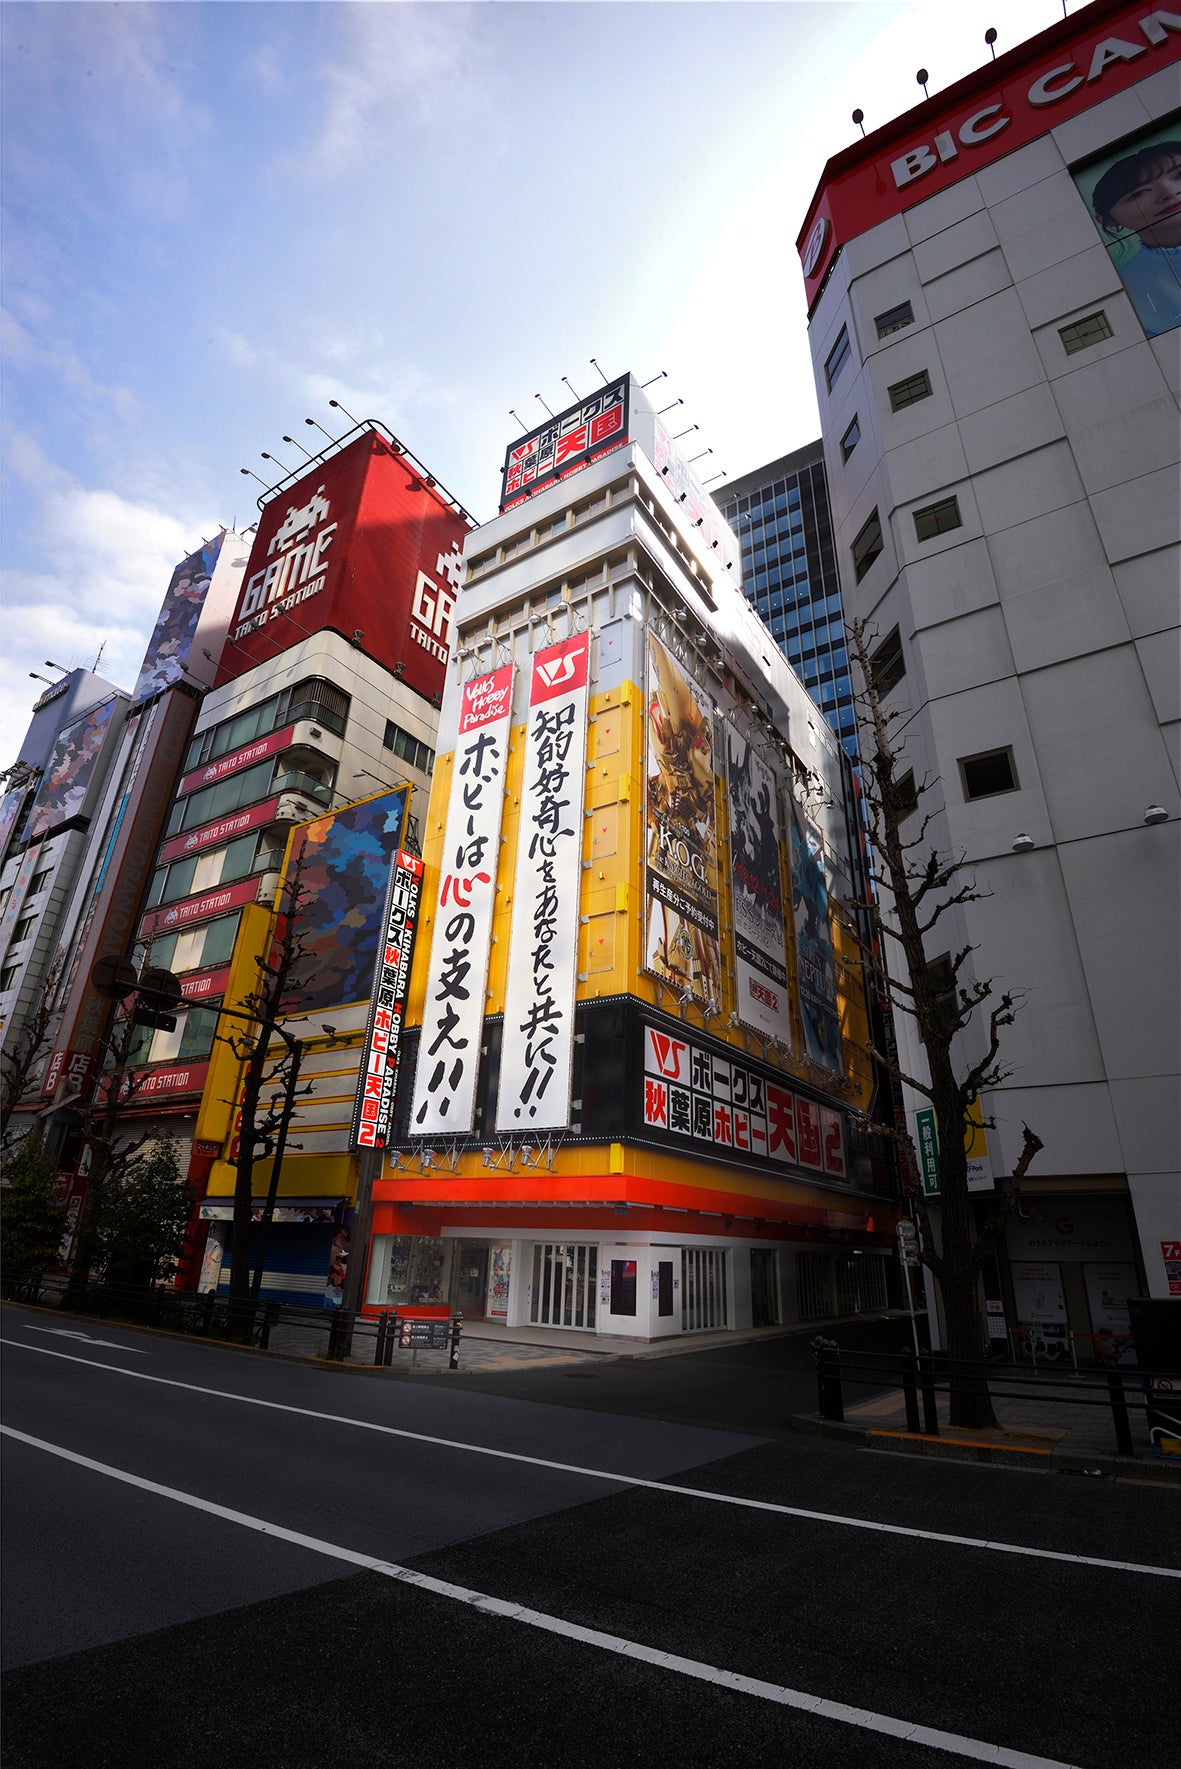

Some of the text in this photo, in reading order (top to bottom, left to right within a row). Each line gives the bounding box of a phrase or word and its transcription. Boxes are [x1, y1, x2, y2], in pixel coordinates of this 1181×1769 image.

[890, 103, 1011, 188] BIC
[541, 385, 624, 447] ボークス
[238, 521, 338, 622] GAME
[409, 621, 448, 665] TAITO
[217, 742, 268, 773] TAITO STATION
[200, 814, 250, 842] TAITO STATION
[658, 824, 709, 885] K.O.G.
[179, 892, 232, 918] TAITO STATION
[181, 978, 212, 996] STATION
[376, 875, 420, 1148] VOLKS AKIHABARA HOBBY PARADISE 2
[158, 1072, 190, 1090] STATION
[693, 1052, 764, 1113] ボークス
[920, 1118, 938, 1189] 一般利用可
